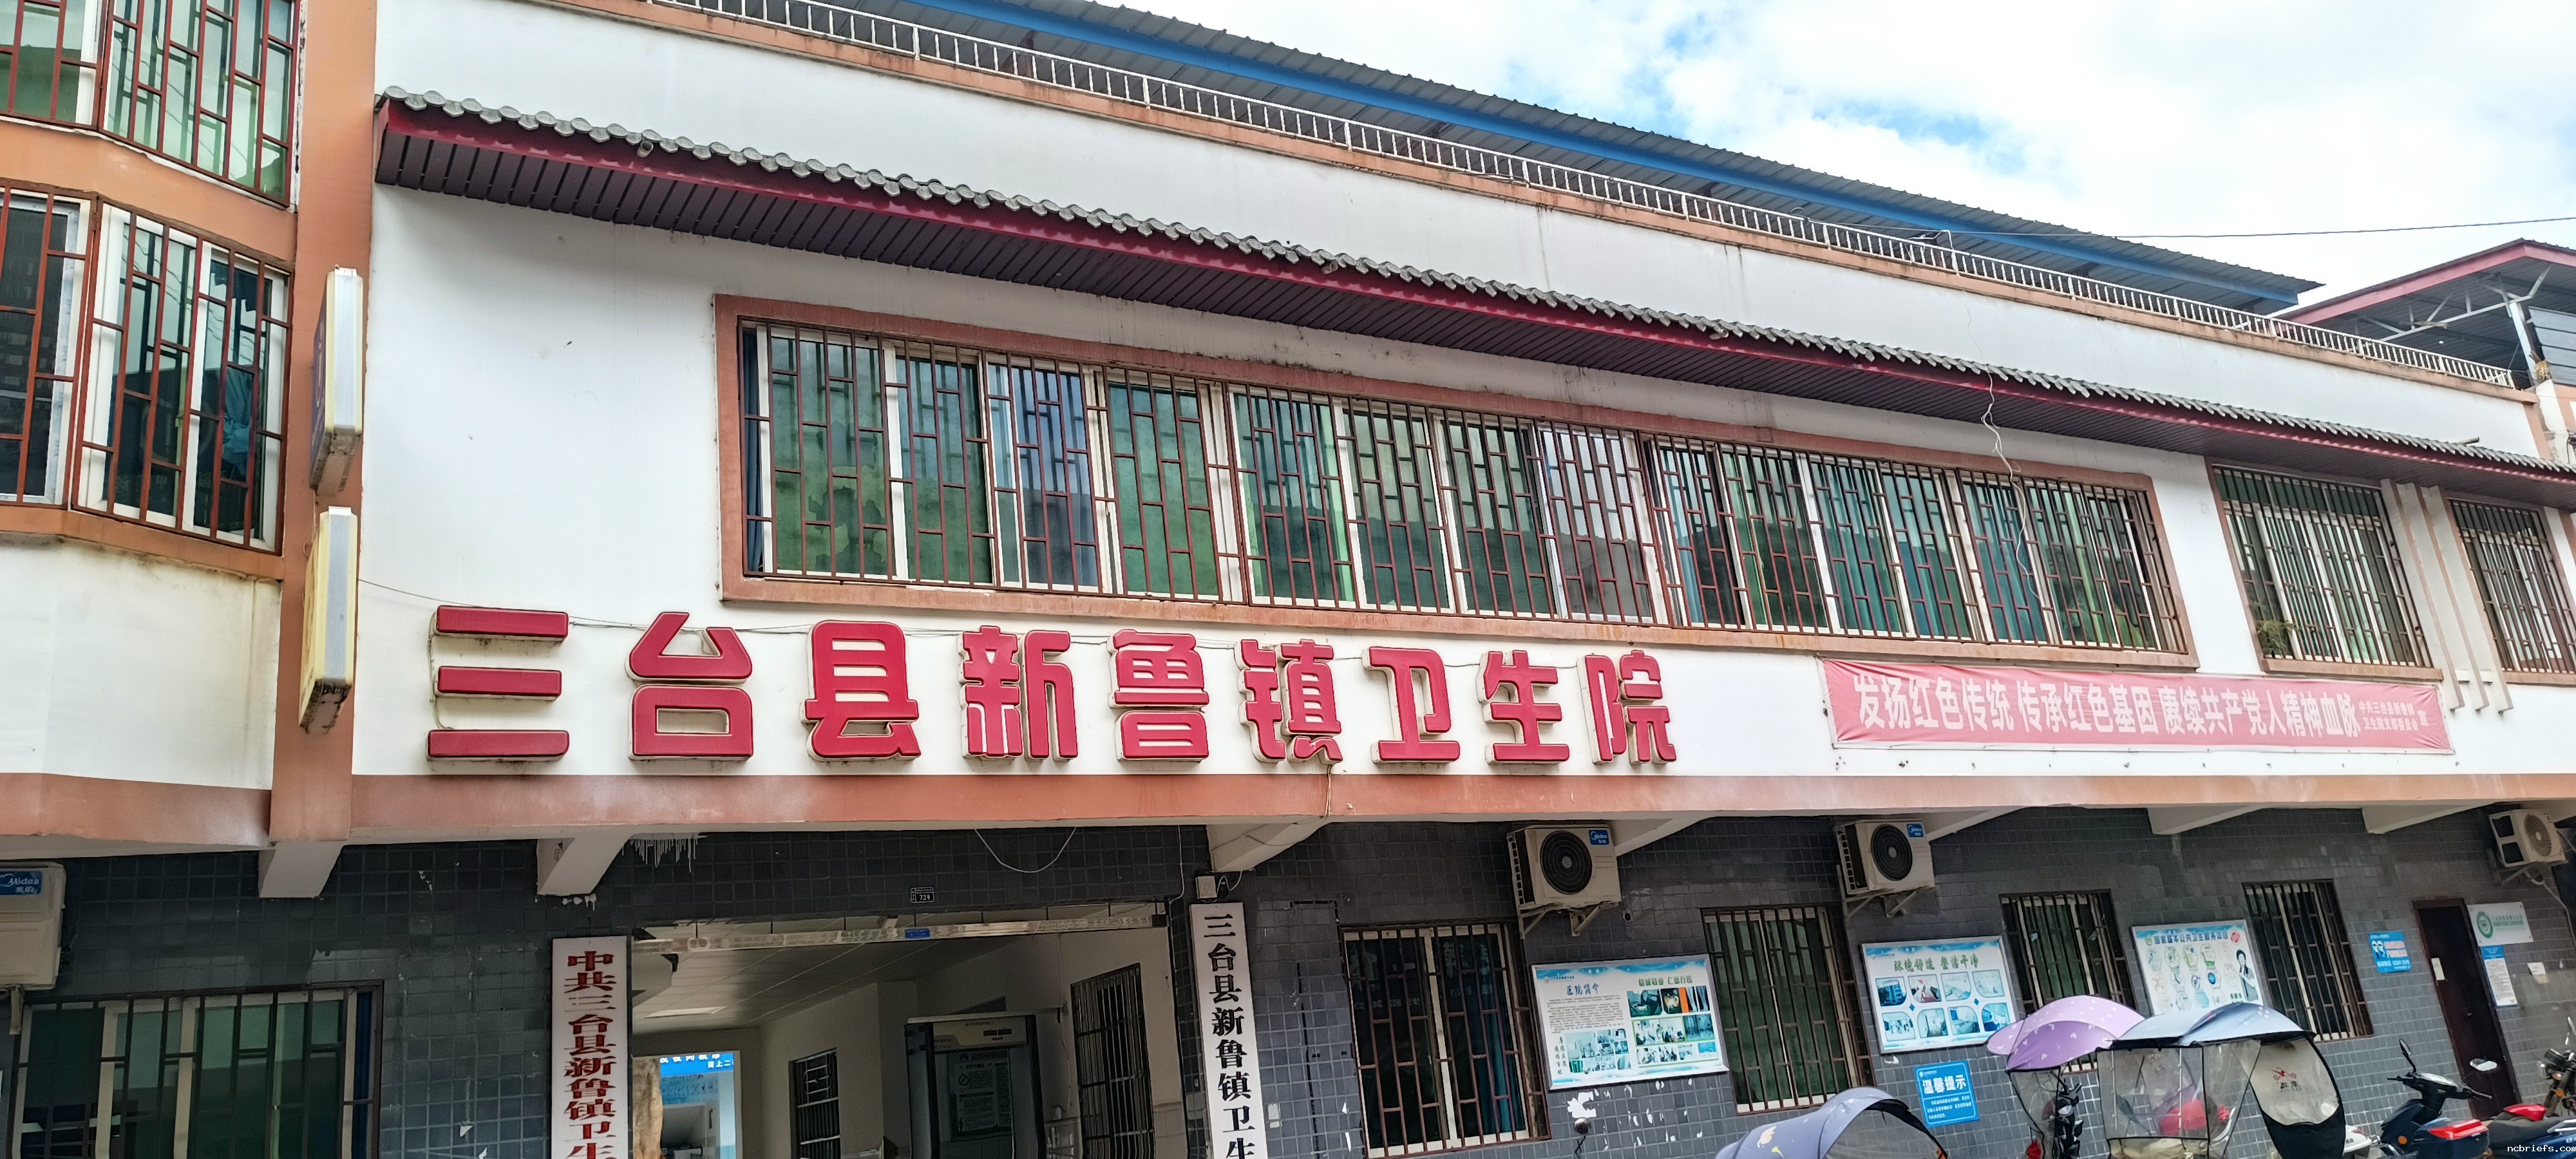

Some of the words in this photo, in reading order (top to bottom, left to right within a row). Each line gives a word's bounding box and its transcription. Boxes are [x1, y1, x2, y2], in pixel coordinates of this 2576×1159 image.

[426, 606, 1677, 764] 三台县新鲁镇卫生院
[1853, 674, 2014, 732] 发扬红色传统
[2016, 679, 2159, 735] 传承红色基因
[2157, 684, 2361, 738] 赓续共产党人精神血脉
[7, 876, 39, 885] Midea
[1566, 983, 1599, 996] 医院简介
[1922, 1074, 1967, 1095] 温馨提示
